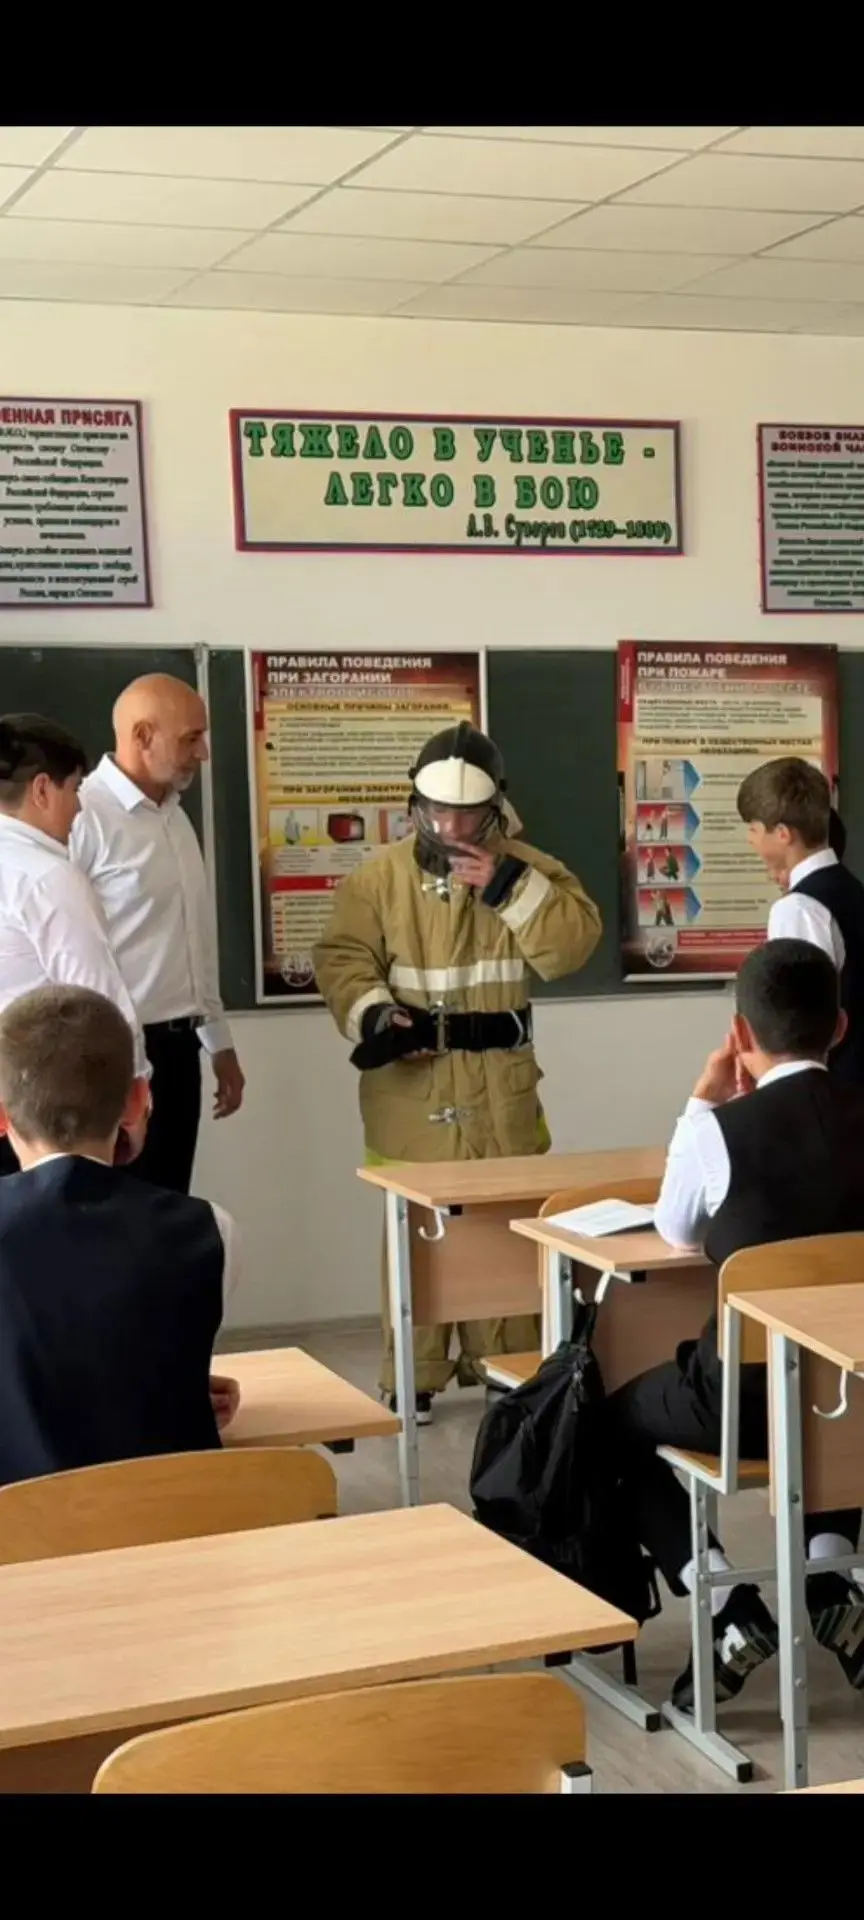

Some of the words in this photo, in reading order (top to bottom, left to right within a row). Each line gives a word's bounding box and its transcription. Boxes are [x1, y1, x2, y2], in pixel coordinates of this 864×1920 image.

[0, 407, 55, 424] ЕННАЯ
[60, 408, 134, 426] ПРИСЯГА
[244, 421, 414, 460] ТЯЖЕЛО
[432, 427, 456, 461] В
[474, 429, 625, 465] УЧЕНЬЕ
[324, 471, 455, 507] ЛЕГКО
[473, 474, 496, 508] В
[514, 475, 599, 510] БОЮ
[505, 513, 566, 546] Суворов
[266, 656, 339, 669] ПРАВИЛА
[343, 656, 432, 670] ПОВЕДЕНИЯ
[637, 652, 701, 664] ПРАВИЛА
[705, 653, 788, 666] ПОВЕДЕНИЯ
[267, 672, 299, 684] ПРИ
[303, 672, 392, 684] ЗАГОРАНИИ
[637, 667, 666, 678] ПРИ
[668, 667, 727, 679] ПОЖАРЕ
